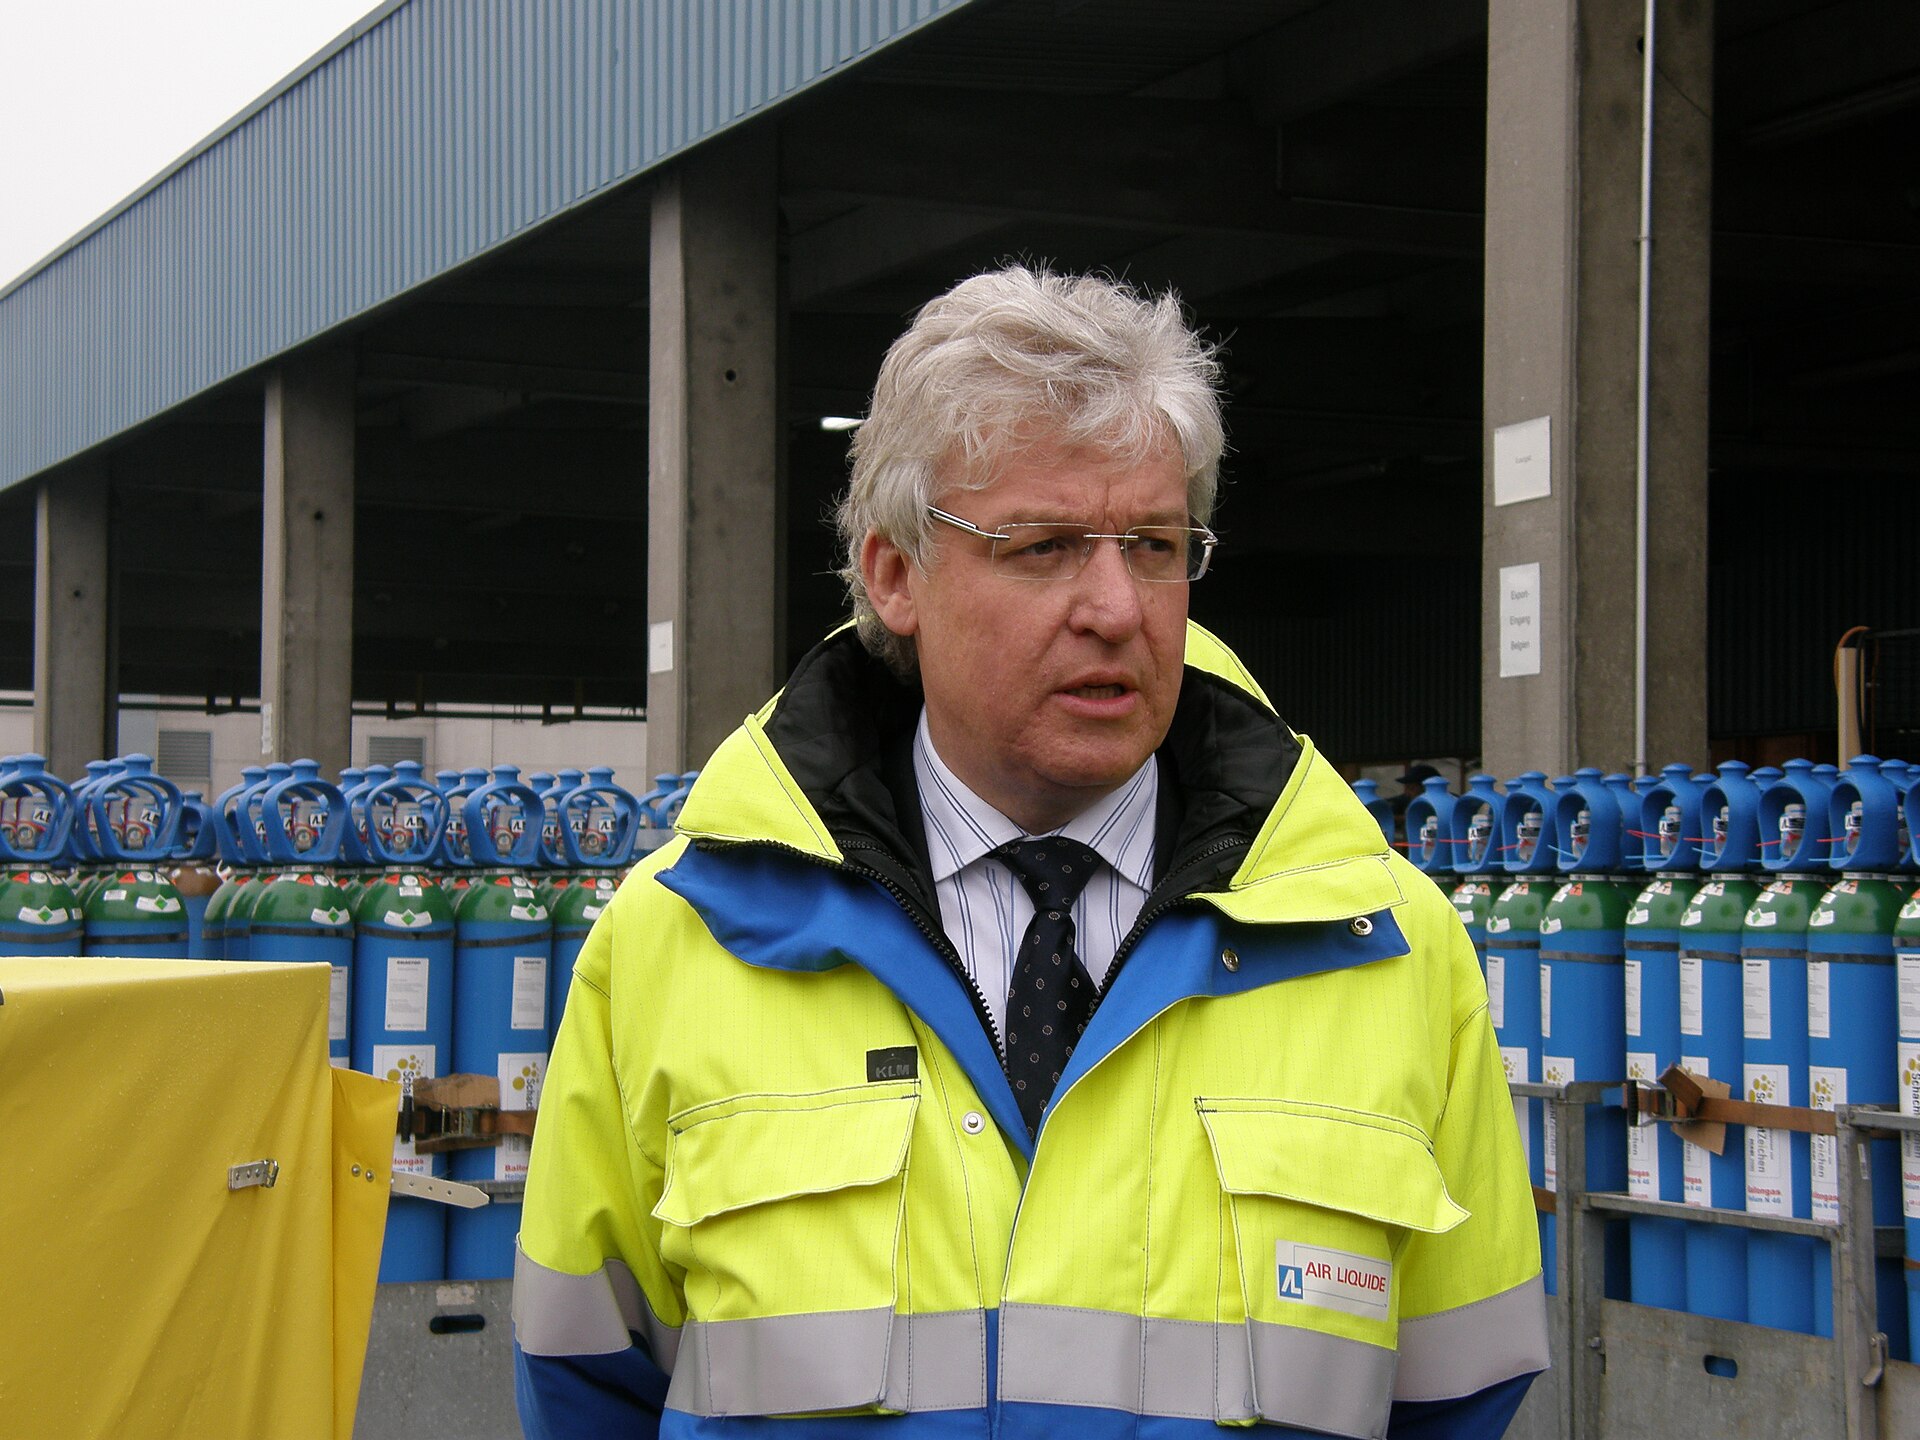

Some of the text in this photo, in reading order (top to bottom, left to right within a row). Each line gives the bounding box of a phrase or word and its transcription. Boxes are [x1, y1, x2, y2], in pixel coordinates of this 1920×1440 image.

[876, 1064, 910, 1078] KLM
[1305, 1261, 1331, 1280] AIR
[1337, 1267, 1386, 1292] LIQUIDE
